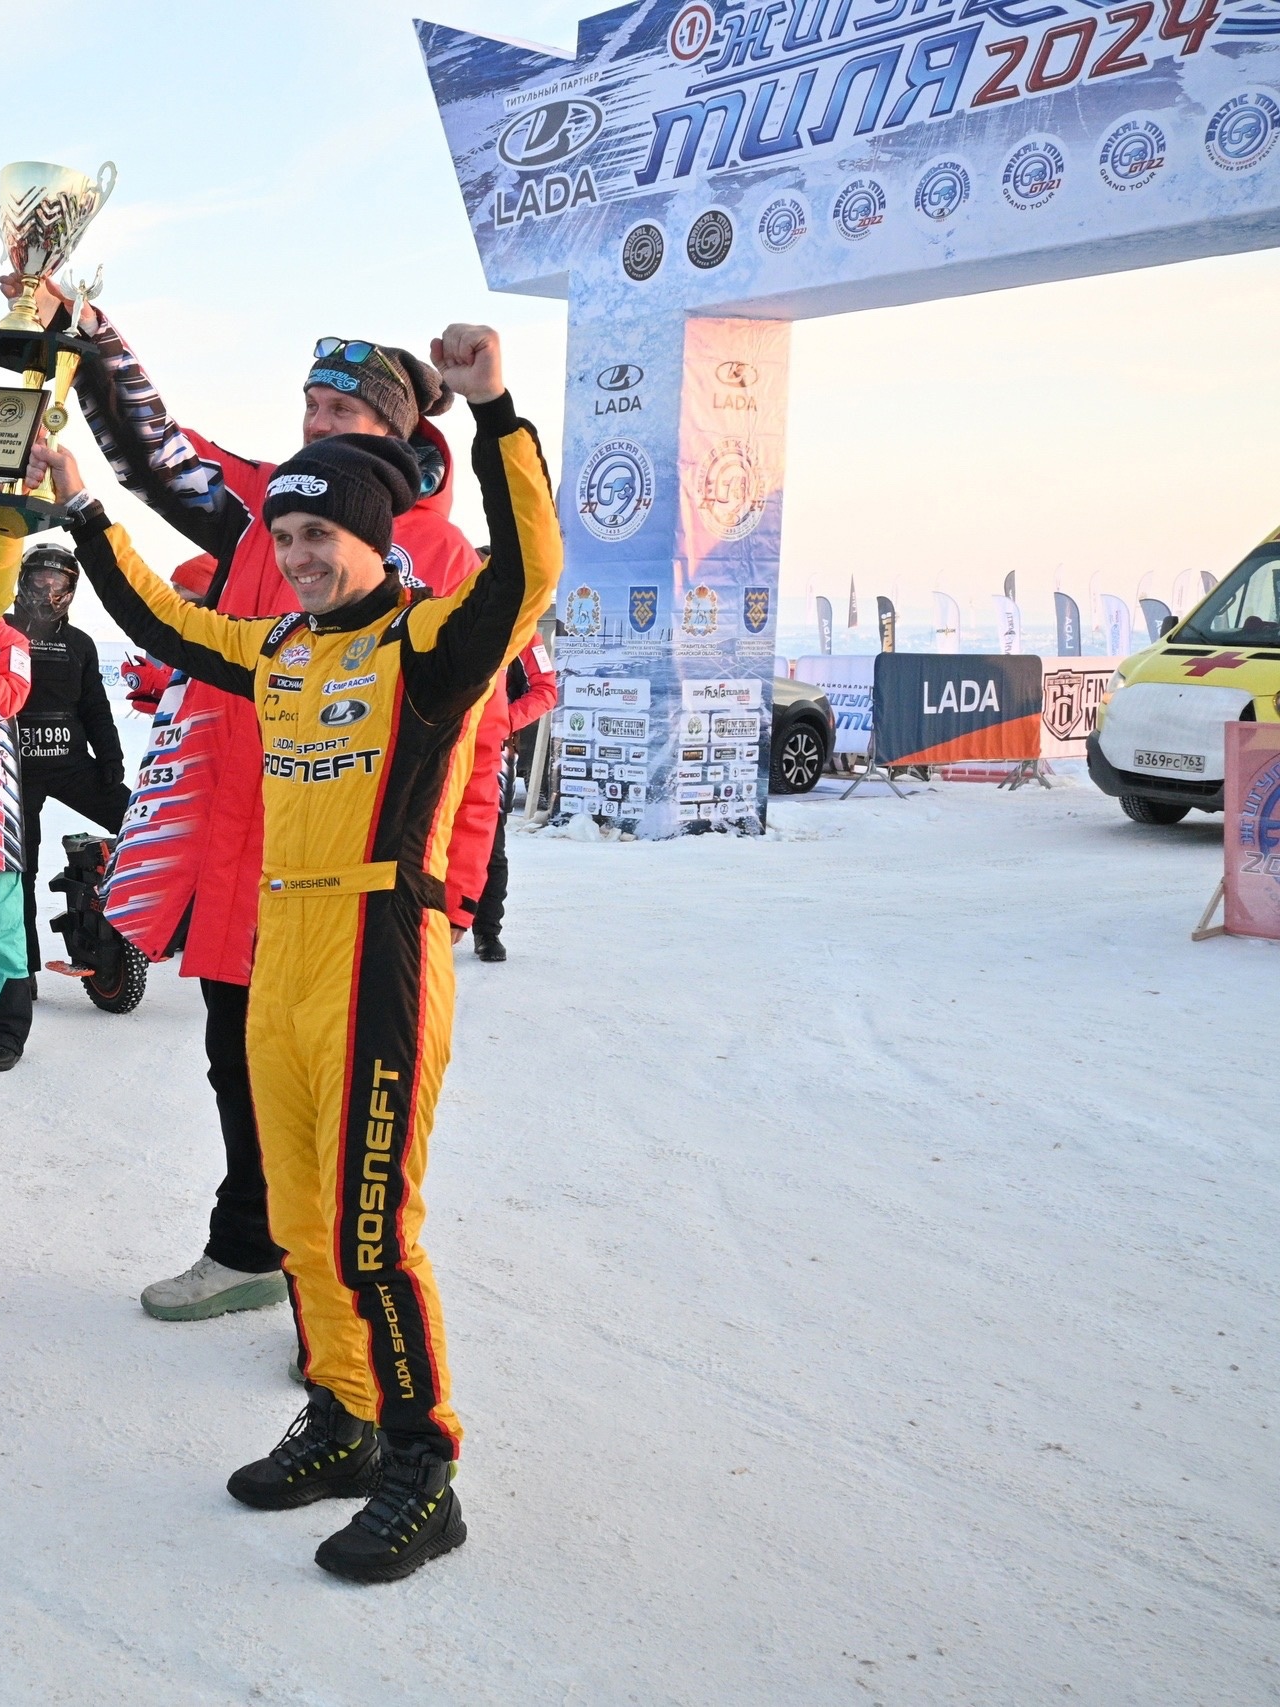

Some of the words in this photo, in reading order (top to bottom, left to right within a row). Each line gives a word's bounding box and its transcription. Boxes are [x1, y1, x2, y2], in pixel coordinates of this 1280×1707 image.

[505, 83, 560, 108] ТИТУЛЬНЫЙ
[561, 71, 600, 95] ПАРТНЕР
[634, 21, 985, 187] МИЛЯ
[970, 0, 1222, 108] 2024
[1205, 93, 1249, 144] BALTIC
[1099, 120, 1140, 166] BAIKAL
[1143, 120, 1166, 154] MILE
[1205, 144, 1215, 161] OPEN
[1214, 160, 1234, 172] WATER
[1235, 160, 1258, 172] SPEED
[1002, 141, 1040, 185] BAIKAL
[1042, 141, 1065, 175] MILE
[1099, 168, 1126, 192] GRAND
[1128, 170, 1157, 192] TOUR
[495, 168, 598, 228] LADA
[833, 179, 865, 219] BAIKAL
[867, 179, 887, 211] MILE
[1002, 187, 1027, 211] GRAND
[1029, 191, 1056, 211] TOUR
[758, 198, 787, 234] BAIKAL
[789, 198, 806, 227] MILE
[595, 395, 643, 416] LADA
[712, 392, 758, 412] LADA
[579, 441, 639, 499] ЖИГУЛЕВСКАЯ
[579, 501, 599, 514] 20
[635, 498, 653, 511] 24
[268, 611, 302, 644] sparco
[822, 618, 832, 650] LADA
[1065, 616, 1075, 649] LADA
[332, 681, 348, 691] SMP
[347, 674, 376, 688] RACING
[923, 679, 1001, 715] LADA
[36, 727, 71, 743] 1980
[154, 726, 182, 747] 470
[612, 728, 645, 737] MECHANICS
[624, 720, 644, 729] CUSTOM
[20, 744, 70, 757] Columbia
[272, 738, 294, 751] LADA
[296, 737, 350, 755] SPORT
[1182, 755, 1203, 767] 763
[136, 766, 174, 790] 1433
[264, 749, 381, 784] ROSNEFT
[357, 1058, 401, 1272] ROSNEFT
[374, 1281, 407, 1354] SPORT
[395, 1358, 415, 1400] LADA
